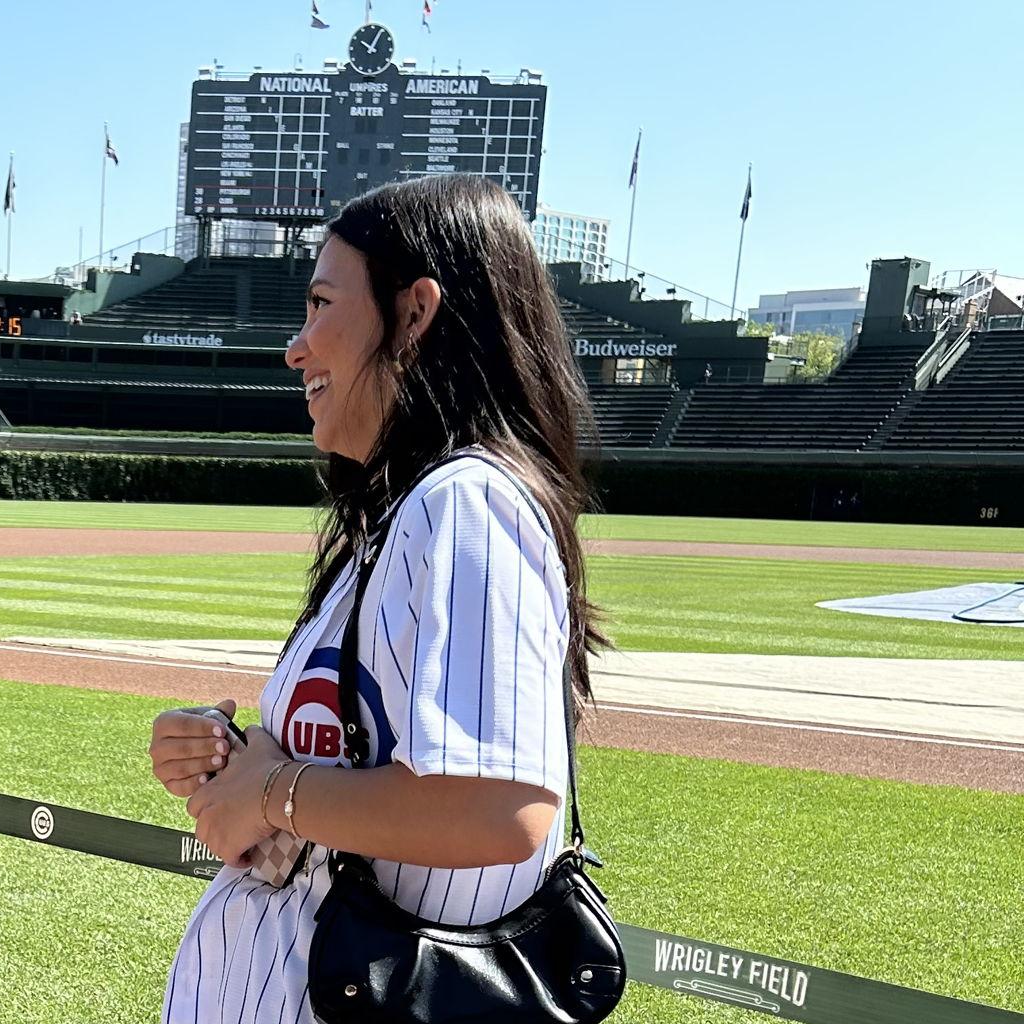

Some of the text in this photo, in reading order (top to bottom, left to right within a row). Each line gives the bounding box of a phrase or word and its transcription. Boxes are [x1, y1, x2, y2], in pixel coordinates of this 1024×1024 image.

[260, 77, 332, 93] NATIONAL
[349, 82, 389, 93] UMPIRES
[405, 79, 479, 94] AMERICAN
[350, 106, 384, 117] BATTER
[153, 332, 223, 347] tastytrade
[575, 339, 677, 357] Budweiser
[654, 939, 809, 1007] WRIGLEY FIELD
